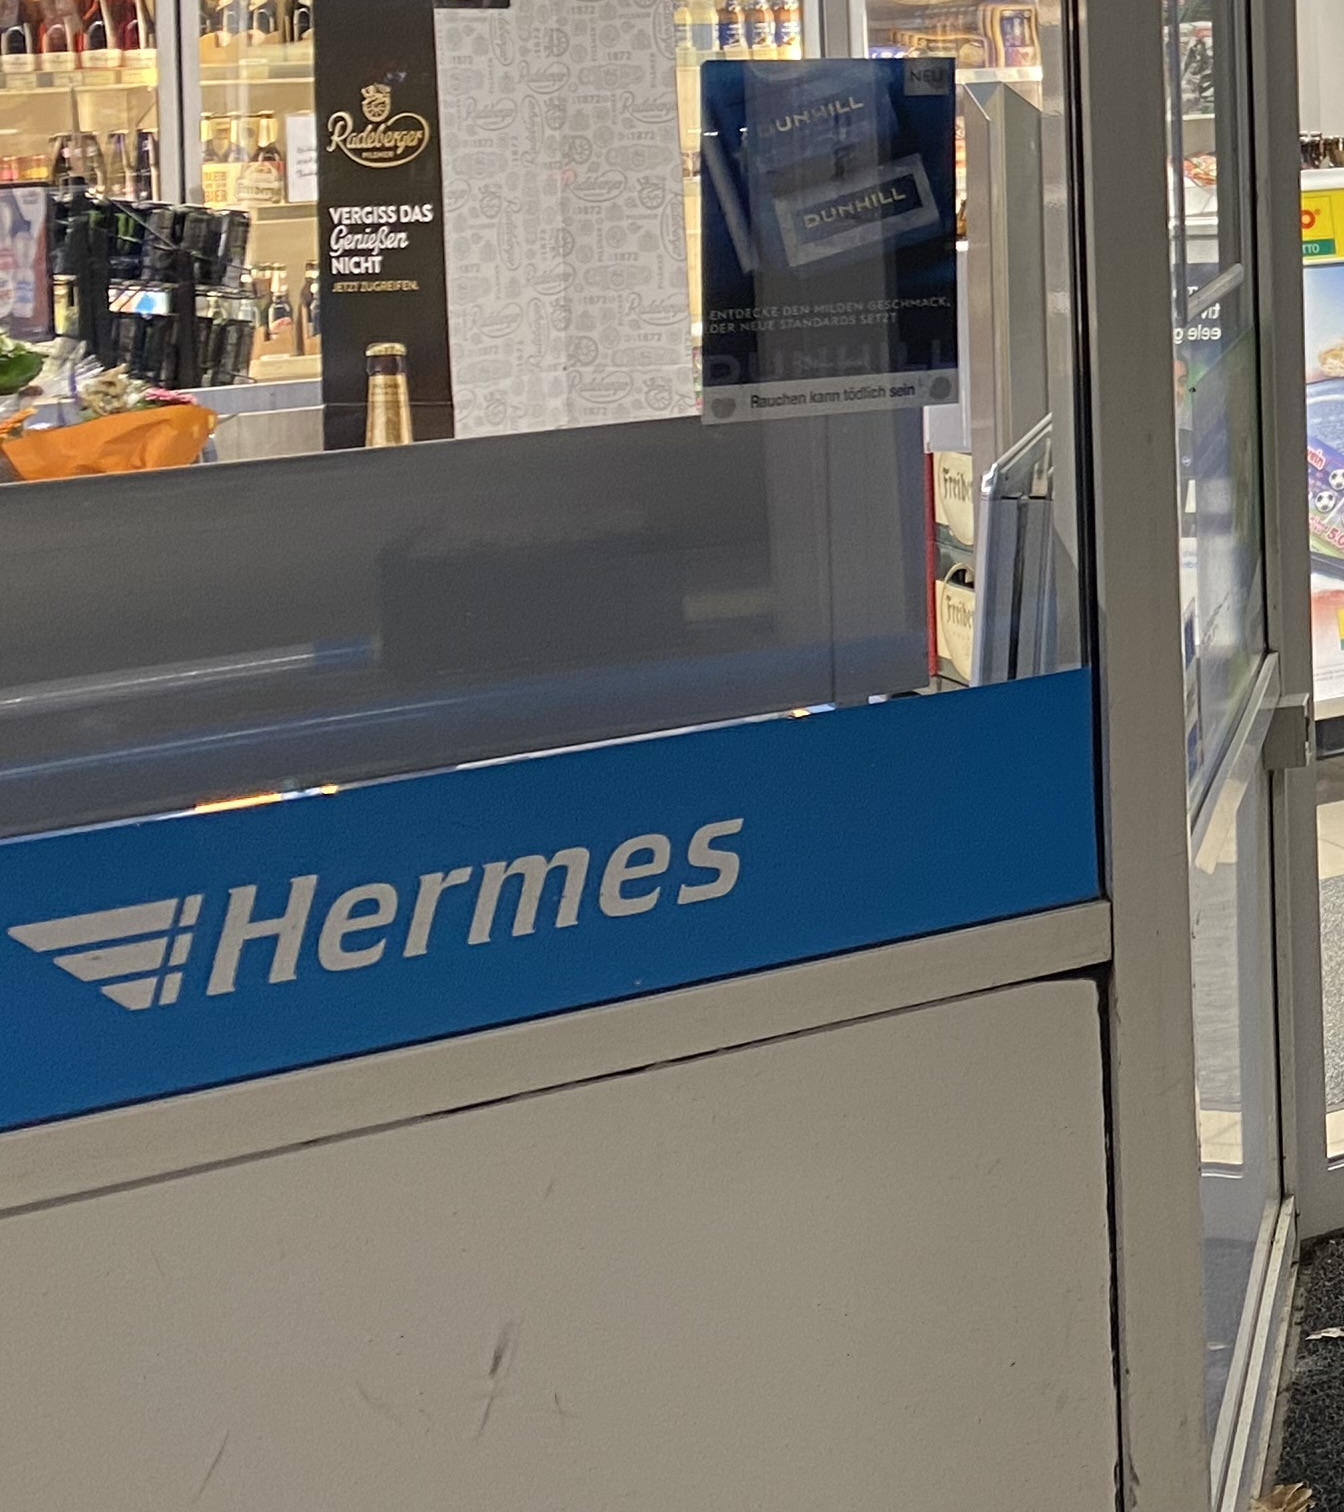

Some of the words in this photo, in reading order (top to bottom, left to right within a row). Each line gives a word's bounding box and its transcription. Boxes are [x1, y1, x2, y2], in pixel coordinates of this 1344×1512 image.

[909, 69, 944, 84] NEU
[326, 111, 430, 168] Radeberger
[329, 205, 397, 224] VERGISS
[399, 205, 433, 223] DAS
[803, 189, 907, 229] DUNHILL
[329, 225, 409, 256] Genießen
[331, 256, 382, 274] NICHT
[710, 305, 779, 321] ENTDECKE
[782, 304, 811, 316] DEN
[814, 301, 864, 314] MILDEN
[709, 322, 736, 335] DER
[740, 320, 775, 333] NEUE
[780, 315, 856, 330] STANDARDS
[750, 392, 806, 409] Rauchen
[809, 389, 841, 405] kann
[844, 385, 886, 402] tödlich
[889, 383, 916, 399] sein
[205, 817, 745, 996] Hermes
